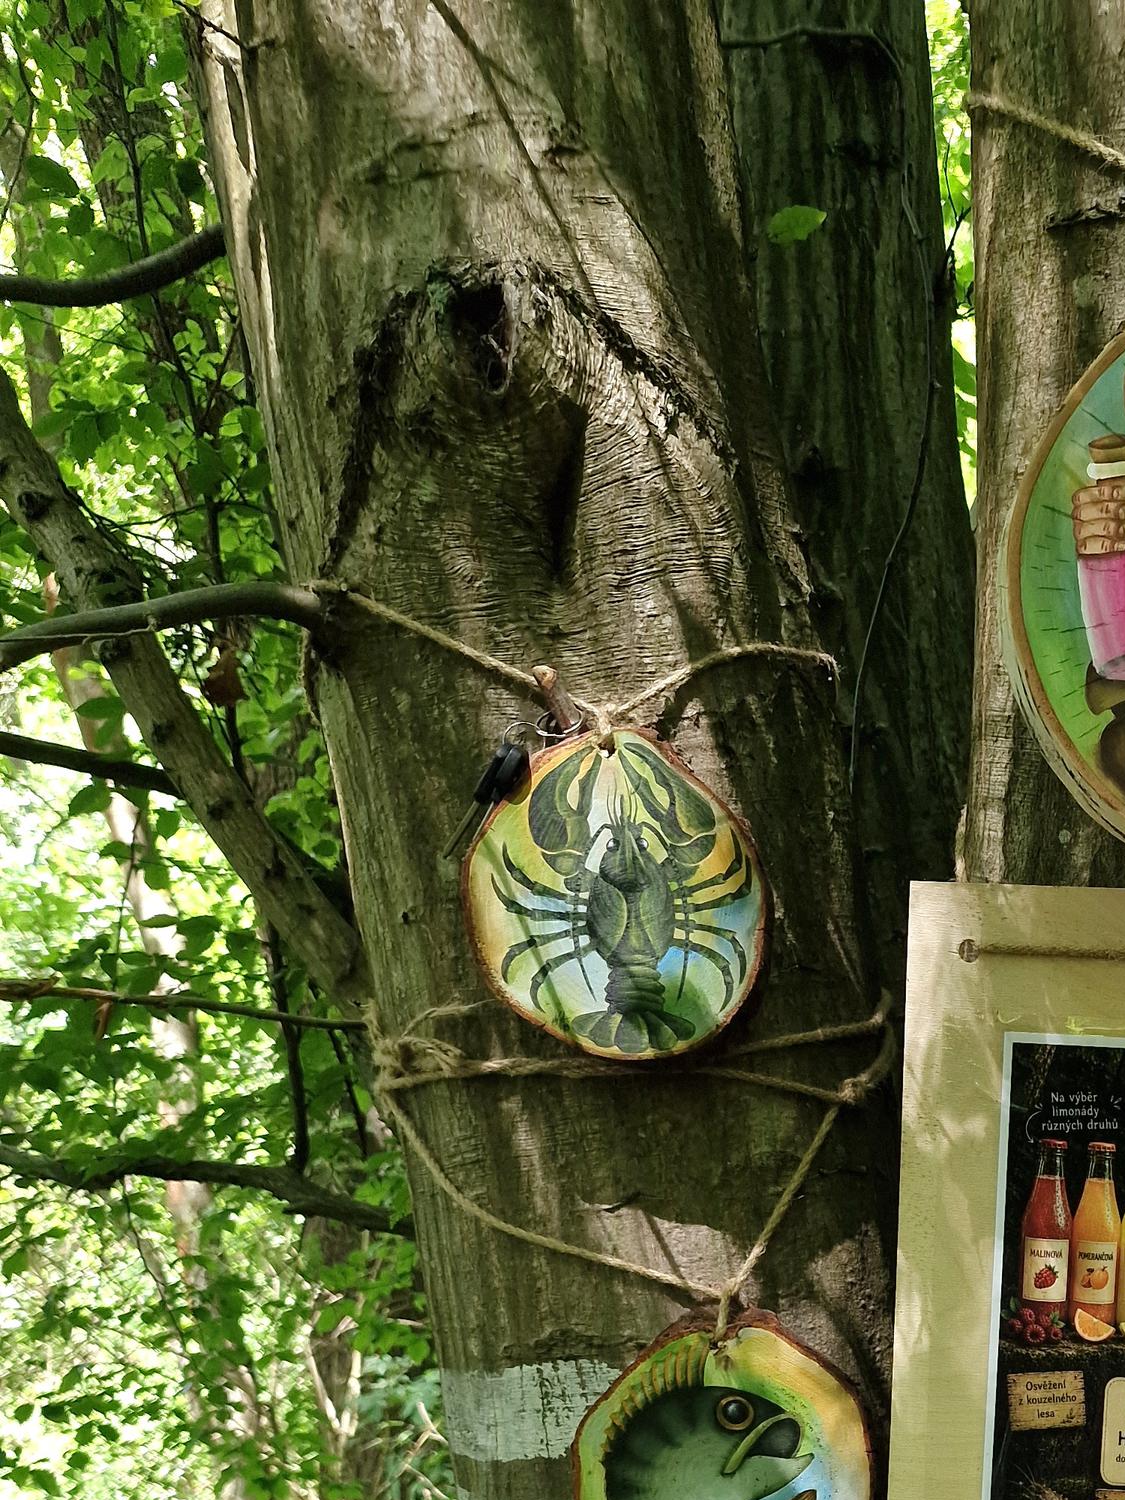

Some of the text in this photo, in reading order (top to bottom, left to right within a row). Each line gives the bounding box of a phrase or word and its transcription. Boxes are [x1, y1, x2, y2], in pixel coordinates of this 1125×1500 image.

[1051, 1091, 1098, 1105] Na výběr
[1052, 1105, 1099, 1118] limonády
[1042, 1118, 1118, 1133] různých druhů
[1029, 1248, 1063, 1259] MALINOVÁ
[1077, 1251, 1114, 1262] POMERANČOVÁ
[1025, 1380, 1066, 1391] Osvěžení
[1019, 1393, 1077, 1406] z kouzelného
[1037, 1409, 1056, 1419] lesa
[1115, 1454, 1125, 1463] do
